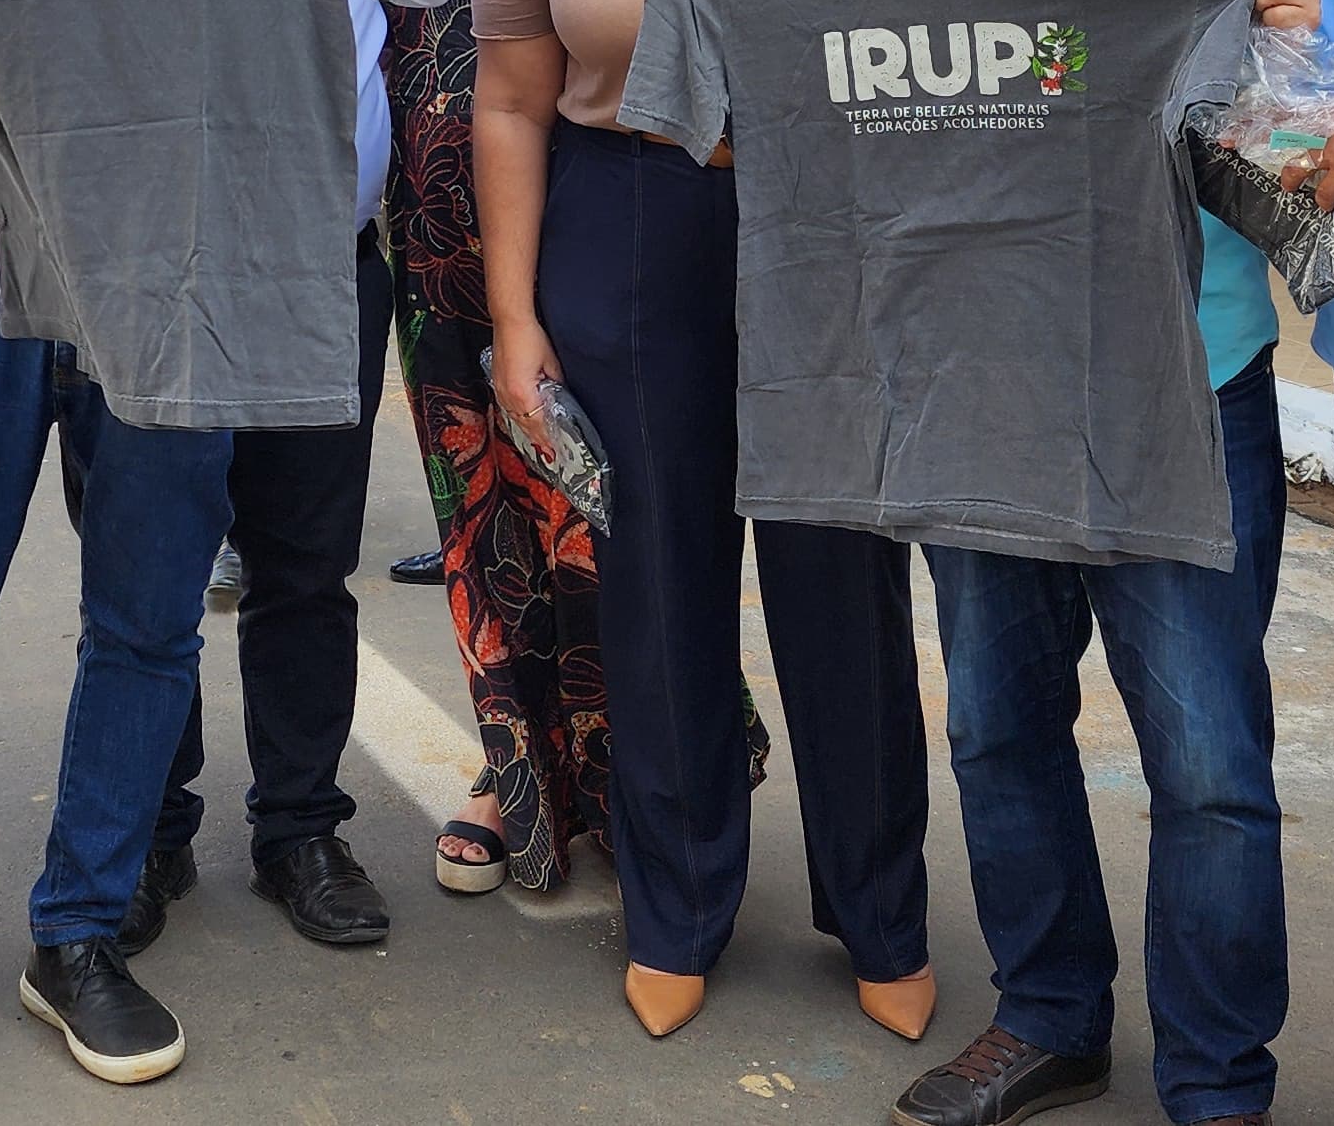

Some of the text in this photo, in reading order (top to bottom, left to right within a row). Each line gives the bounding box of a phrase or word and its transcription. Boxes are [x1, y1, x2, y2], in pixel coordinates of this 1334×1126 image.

[845, 103, 1050, 124] TERRA DE BELEZAS NATURAIS
[853, 117, 1045, 135] E CORAÇÕES ACOLHEDORES
